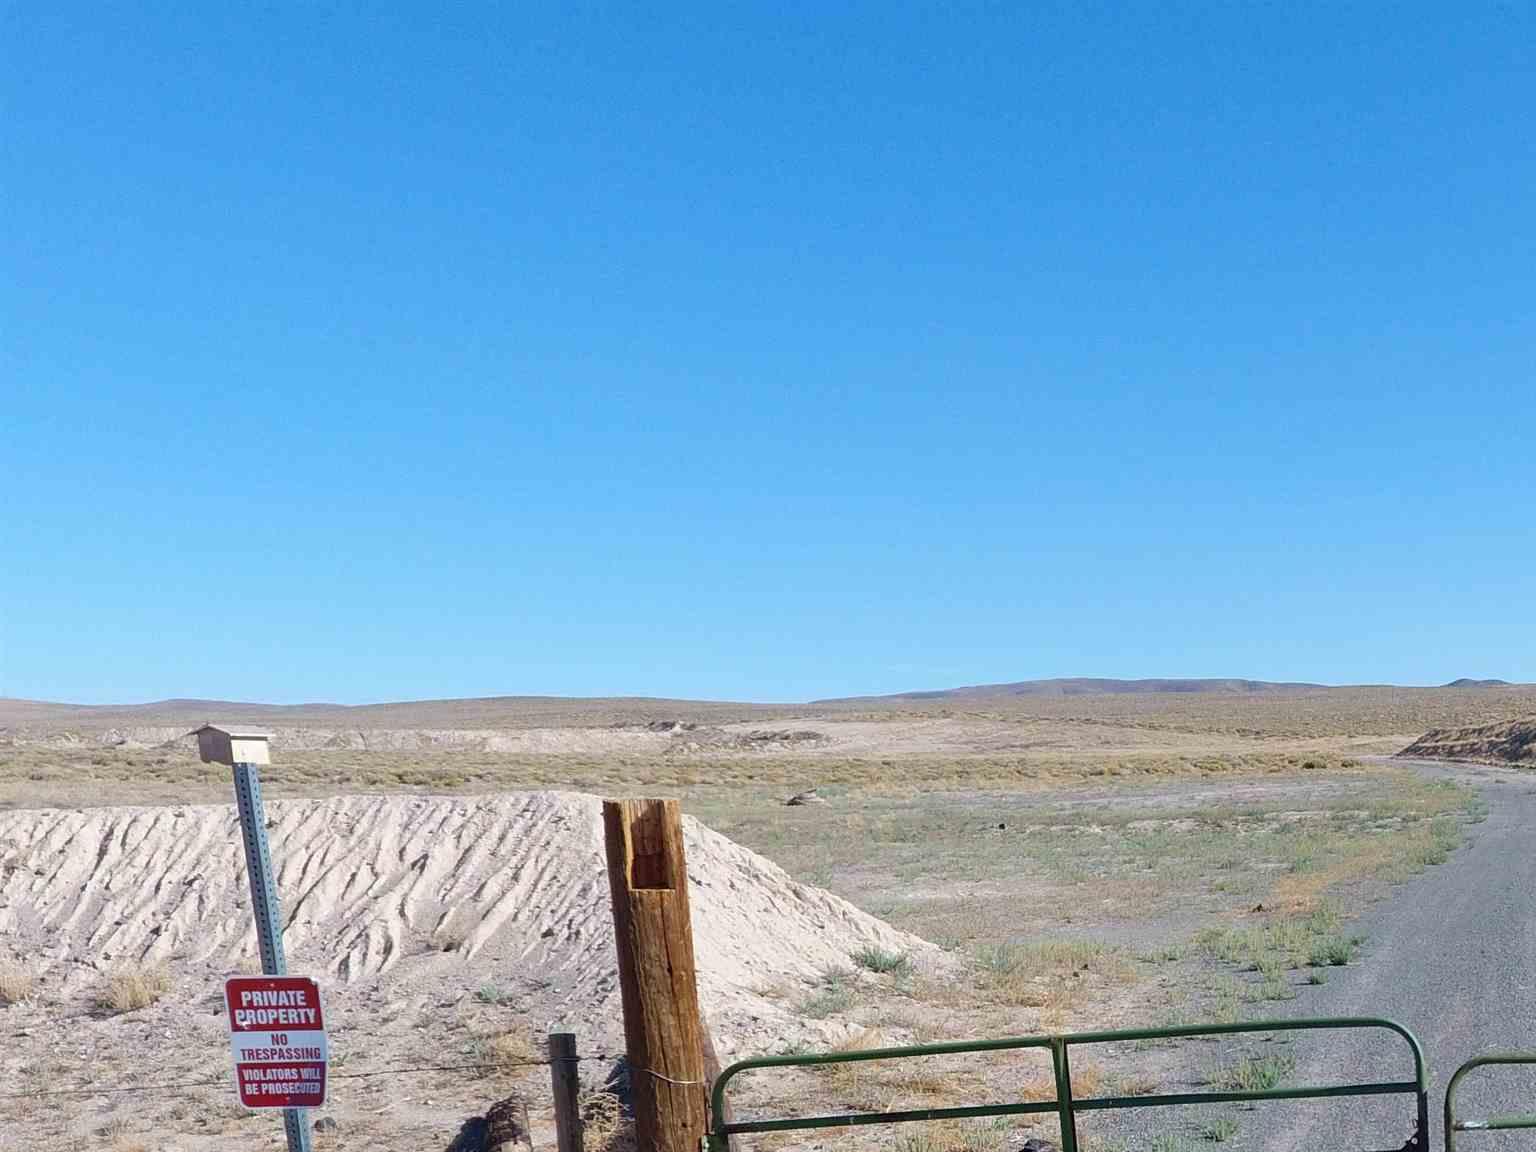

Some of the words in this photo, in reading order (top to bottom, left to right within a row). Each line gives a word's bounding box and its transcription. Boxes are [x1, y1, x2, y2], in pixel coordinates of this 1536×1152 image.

[241, 990, 306, 1006] PRIVATE
[235, 1008, 315, 1025] PROPERTY
[271, 1034, 288, 1046] NO
[240, 1047, 321, 1060] TRESPASSING
[242, 1068, 298, 1081] VIOLATORS
[300, 1067, 321, 1080] WILL
[245, 1083, 260, 1095] BE
[261, 1082, 321, 1095] PROSECUTED
